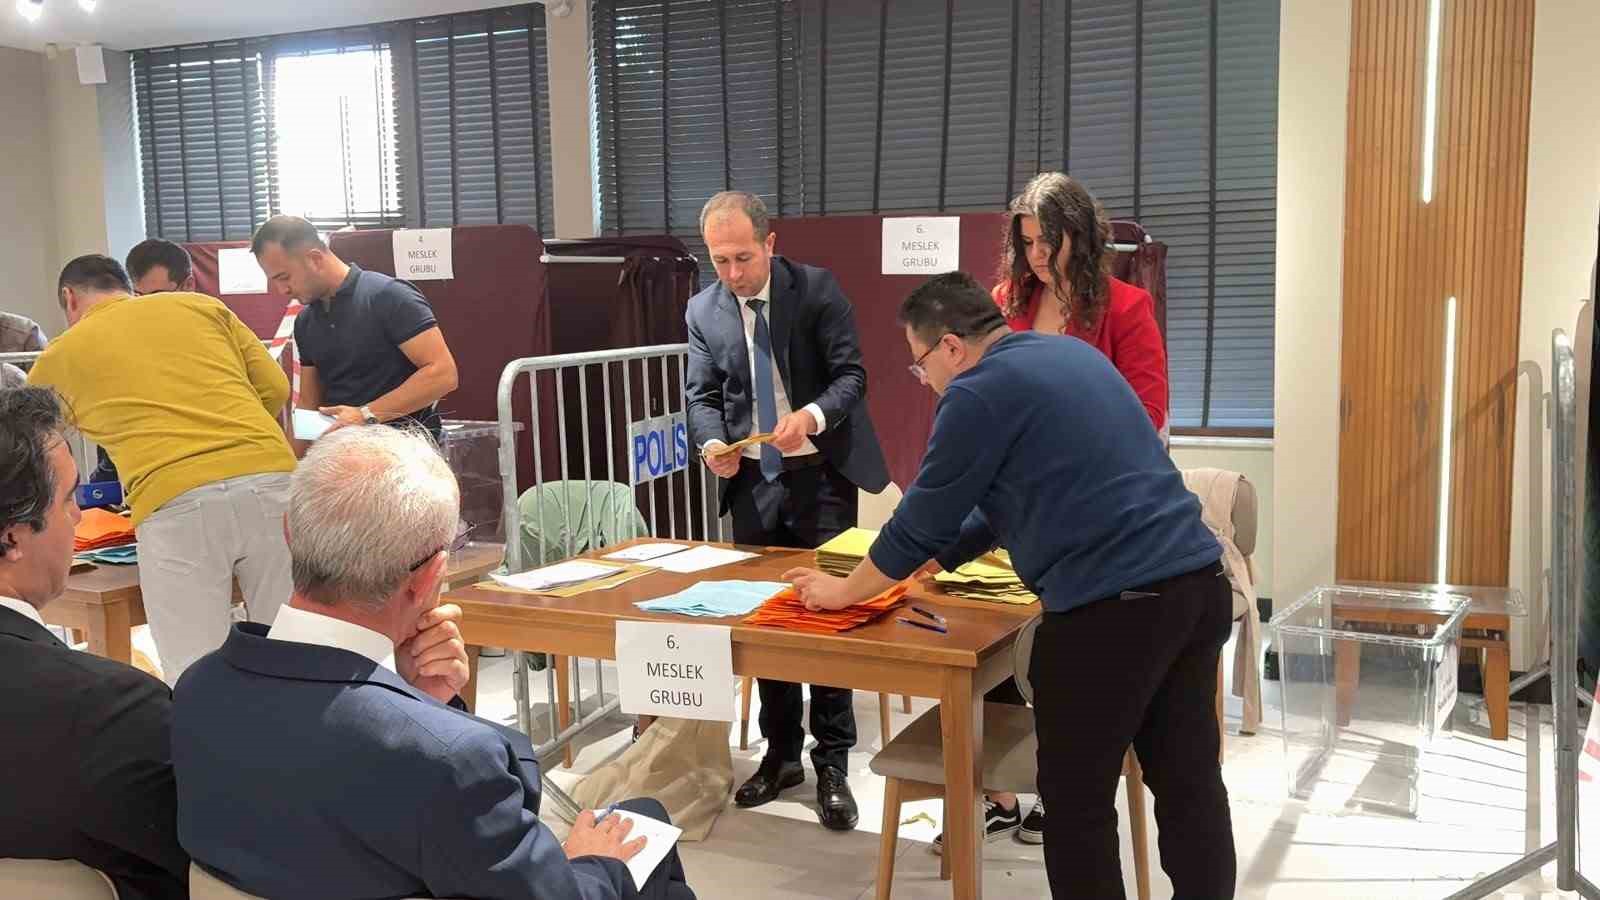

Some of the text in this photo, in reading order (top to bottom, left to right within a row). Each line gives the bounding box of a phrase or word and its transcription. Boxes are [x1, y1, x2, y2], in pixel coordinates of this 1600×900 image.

[901, 241, 940, 251] MESLEK
[408, 249, 439, 259] MESLEK
[902, 257, 938, 267] GRUBU
[409, 264, 437, 274] GRUBU
[634, 417, 687, 481] POLİS
[666, 634, 680, 649] 6.
[647, 662, 704, 680] MESLEK
[650, 689, 703, 707] GRUBU
